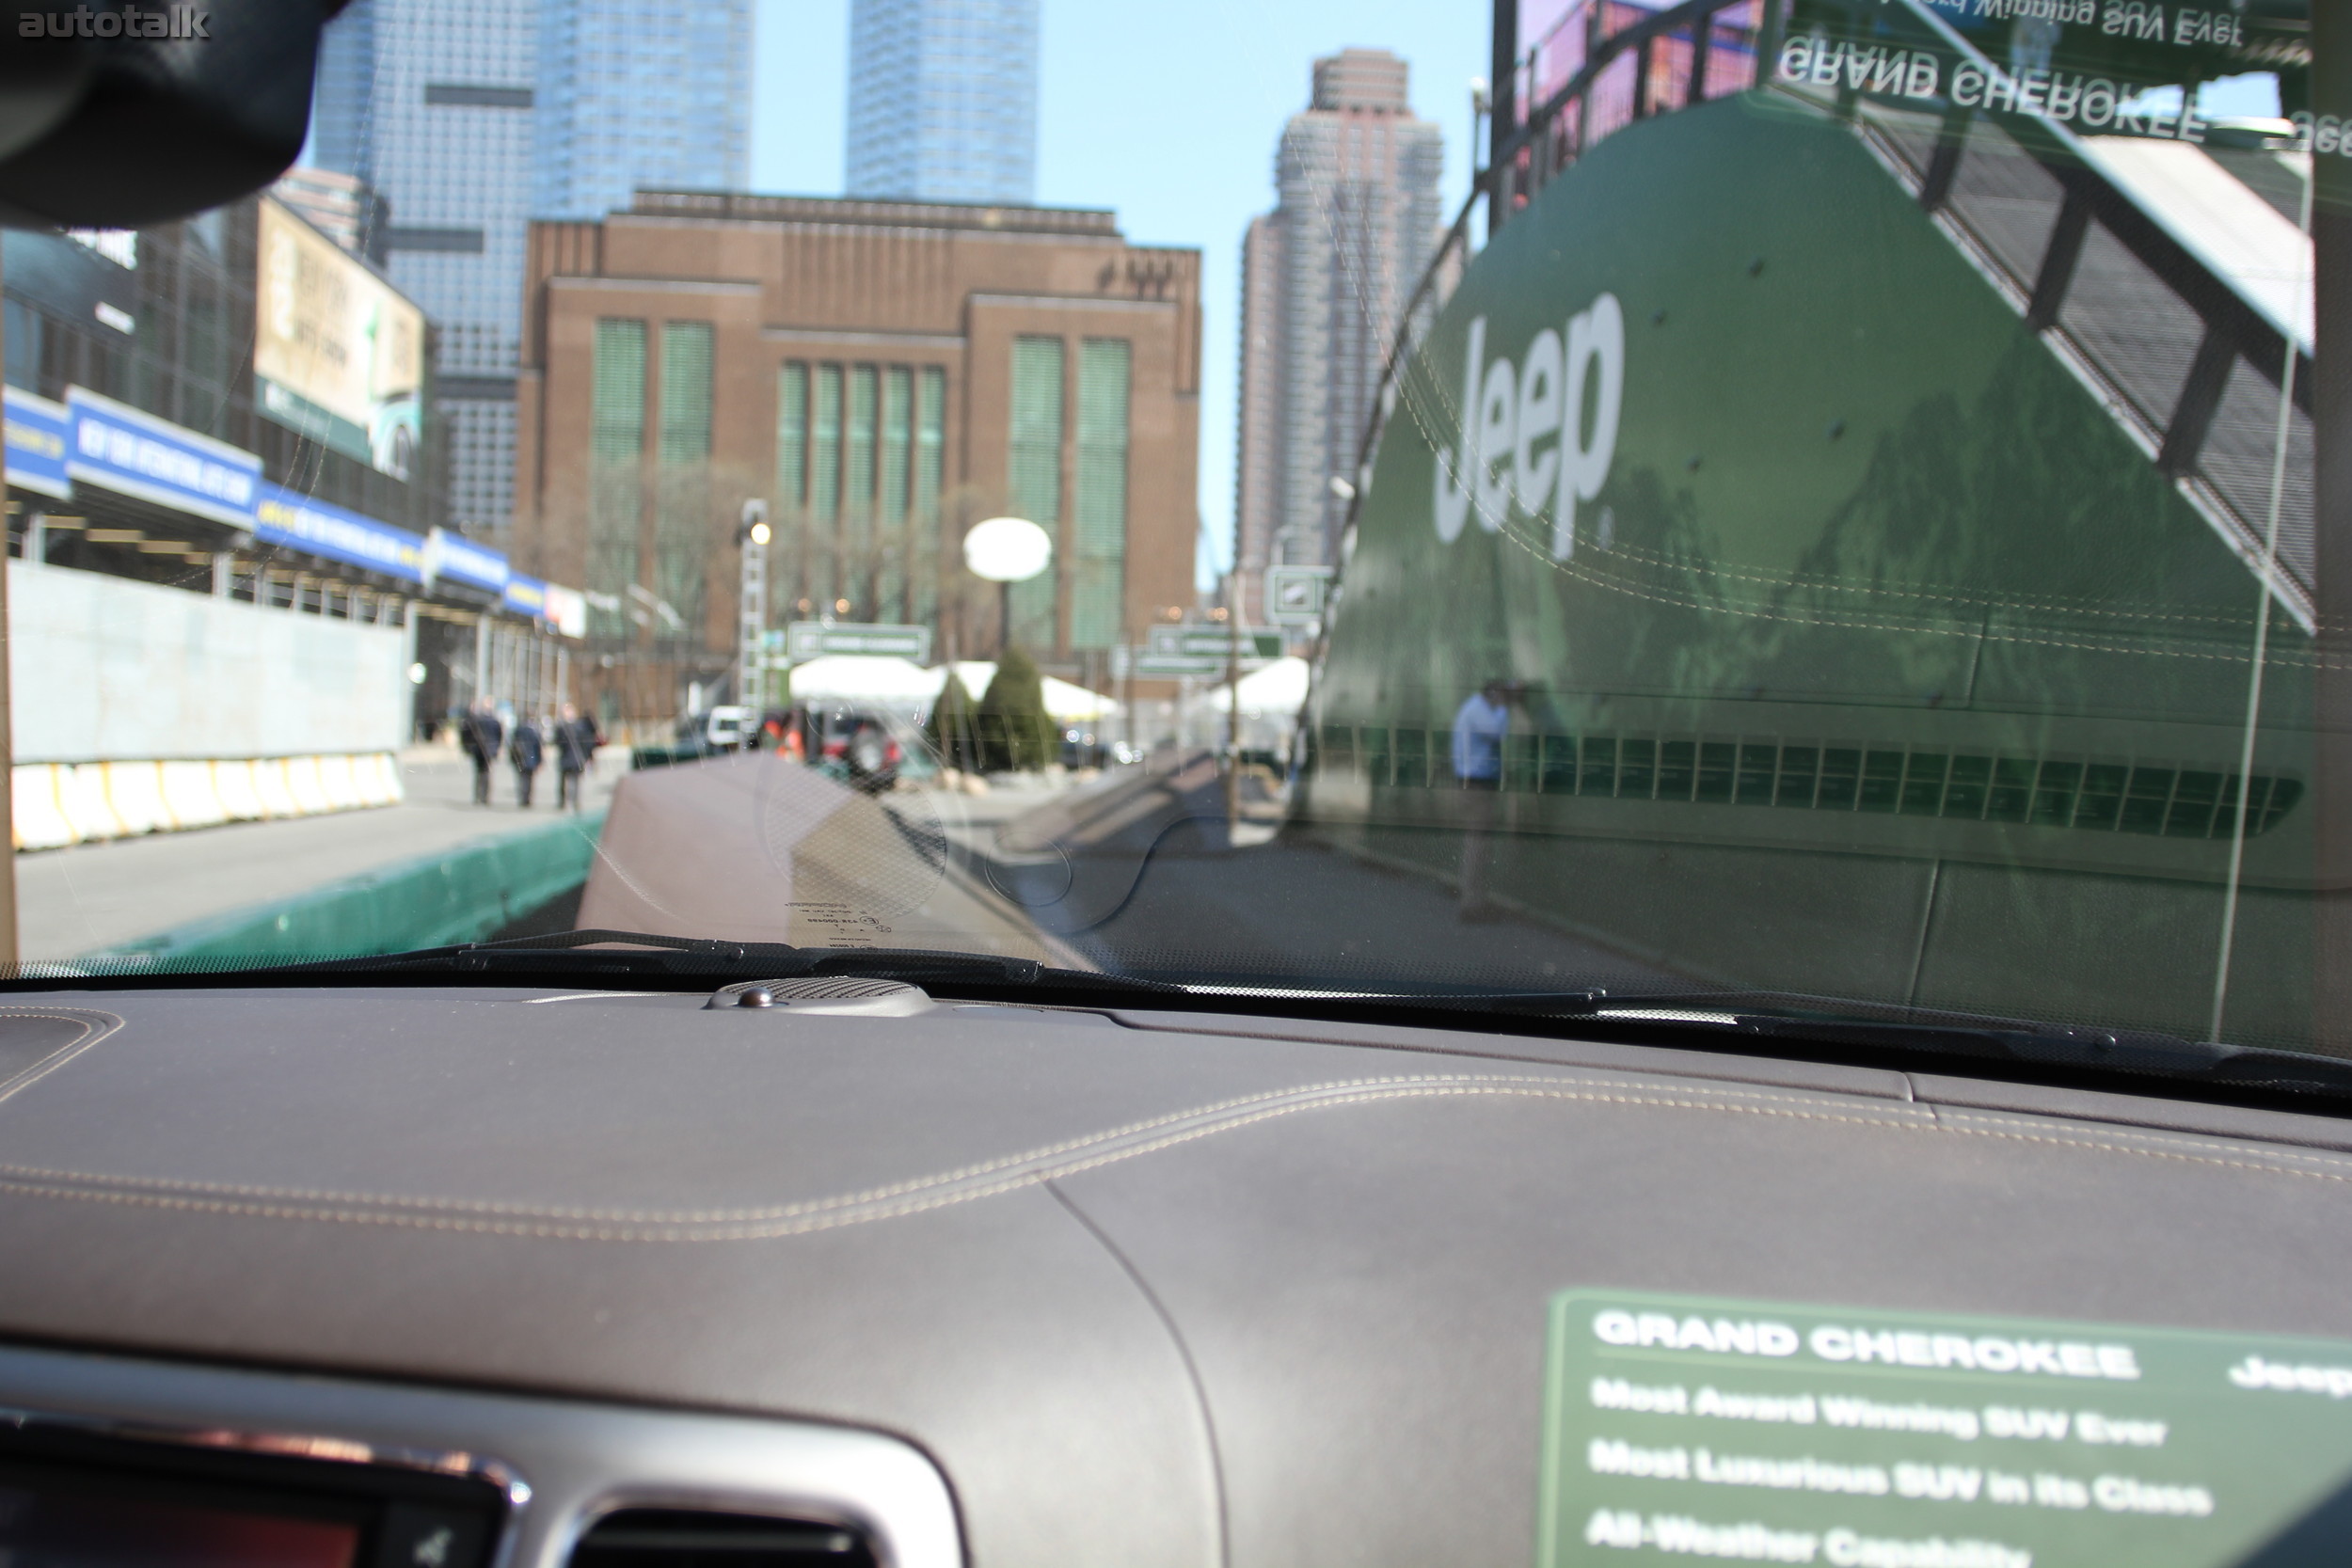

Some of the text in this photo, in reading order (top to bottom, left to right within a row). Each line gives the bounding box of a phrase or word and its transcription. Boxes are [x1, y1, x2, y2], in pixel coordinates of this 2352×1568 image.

[1434, 292, 1626, 562] Jeep
[1594, 1310, 2141, 1380] GRAND CHEROKEE
[1590, 1376, 2169, 1447] Most Award Winning SUV Ever
[1588, 1437, 2215, 1517] Most Luxurious SUV in its Class
[1587, 1509, 1820, 1563] All-Weather
